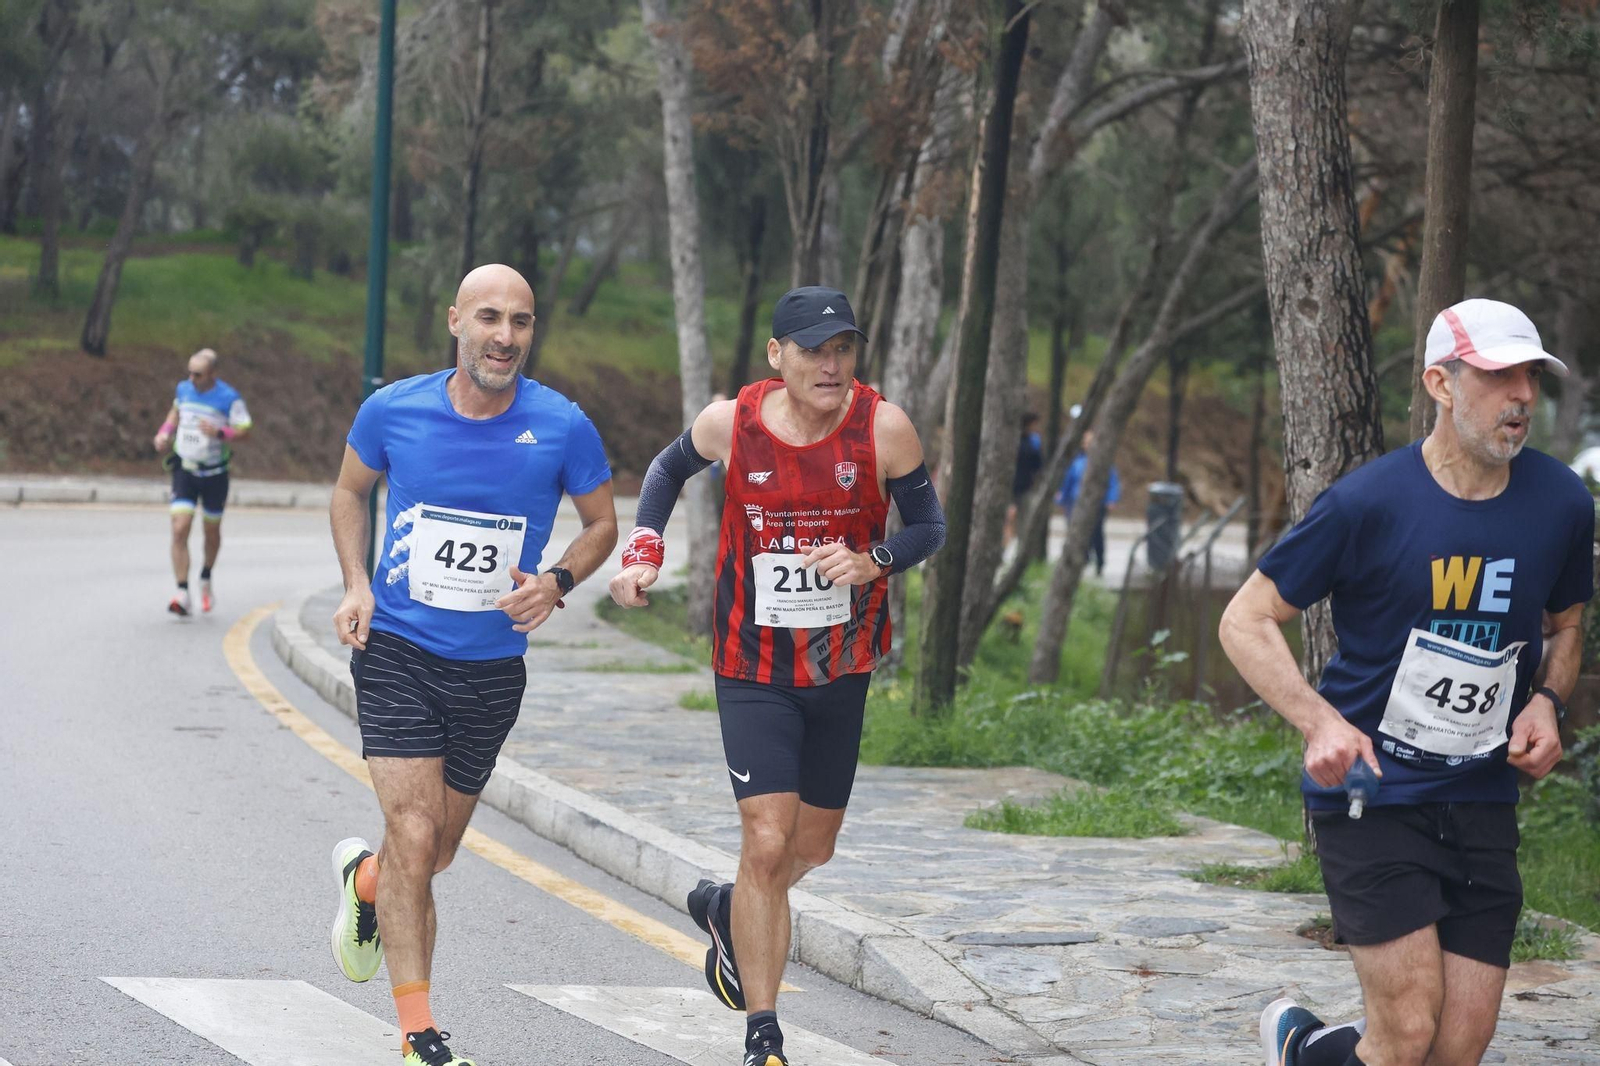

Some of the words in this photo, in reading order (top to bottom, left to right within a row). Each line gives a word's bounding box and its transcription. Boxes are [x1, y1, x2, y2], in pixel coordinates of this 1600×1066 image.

[765, 509, 820, 518] Ayuntamiento
[834, 507, 860, 516] Málaga
[430, 513, 481, 525] www.deporte.malaga.eu
[766, 519, 783, 527] Área
[798, 519, 830, 527] Deporte
[760, 537, 780, 549] LA
[434, 539, 498, 573] 423
[773, 565, 833, 593] 210
[1431, 555, 1515, 613] WE
[440, 584, 463, 592] MARATÓN
[1427, 642, 1491, 666] www.deporte.malaga.eu
[1425, 677, 1500, 714] 438
[1427, 724, 1456, 736] MARATÓN
[1396, 746, 1415, 756] Ciudad
